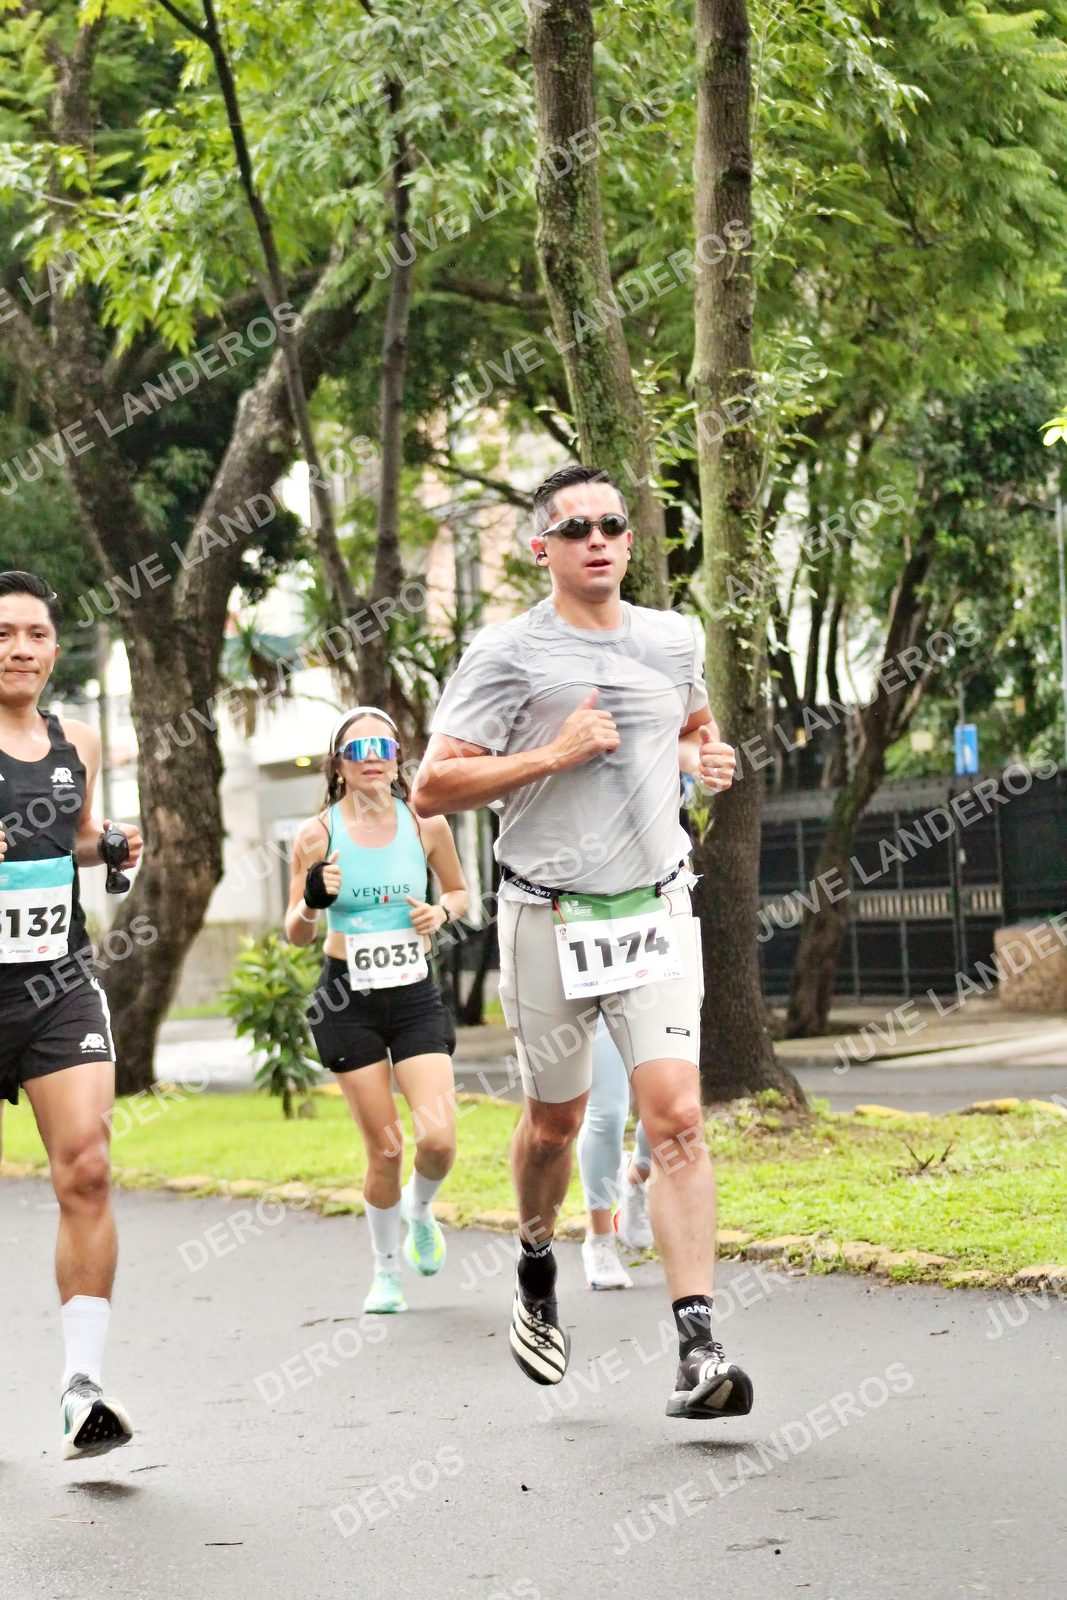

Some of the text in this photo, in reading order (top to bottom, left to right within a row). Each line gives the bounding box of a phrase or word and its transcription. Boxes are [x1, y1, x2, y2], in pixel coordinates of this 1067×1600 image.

[352, 884, 411, 898] VENTUS
[0, 904, 67, 938] 132
[354, 942, 420, 971] 6033
[569, 926, 670, 973] 1174
